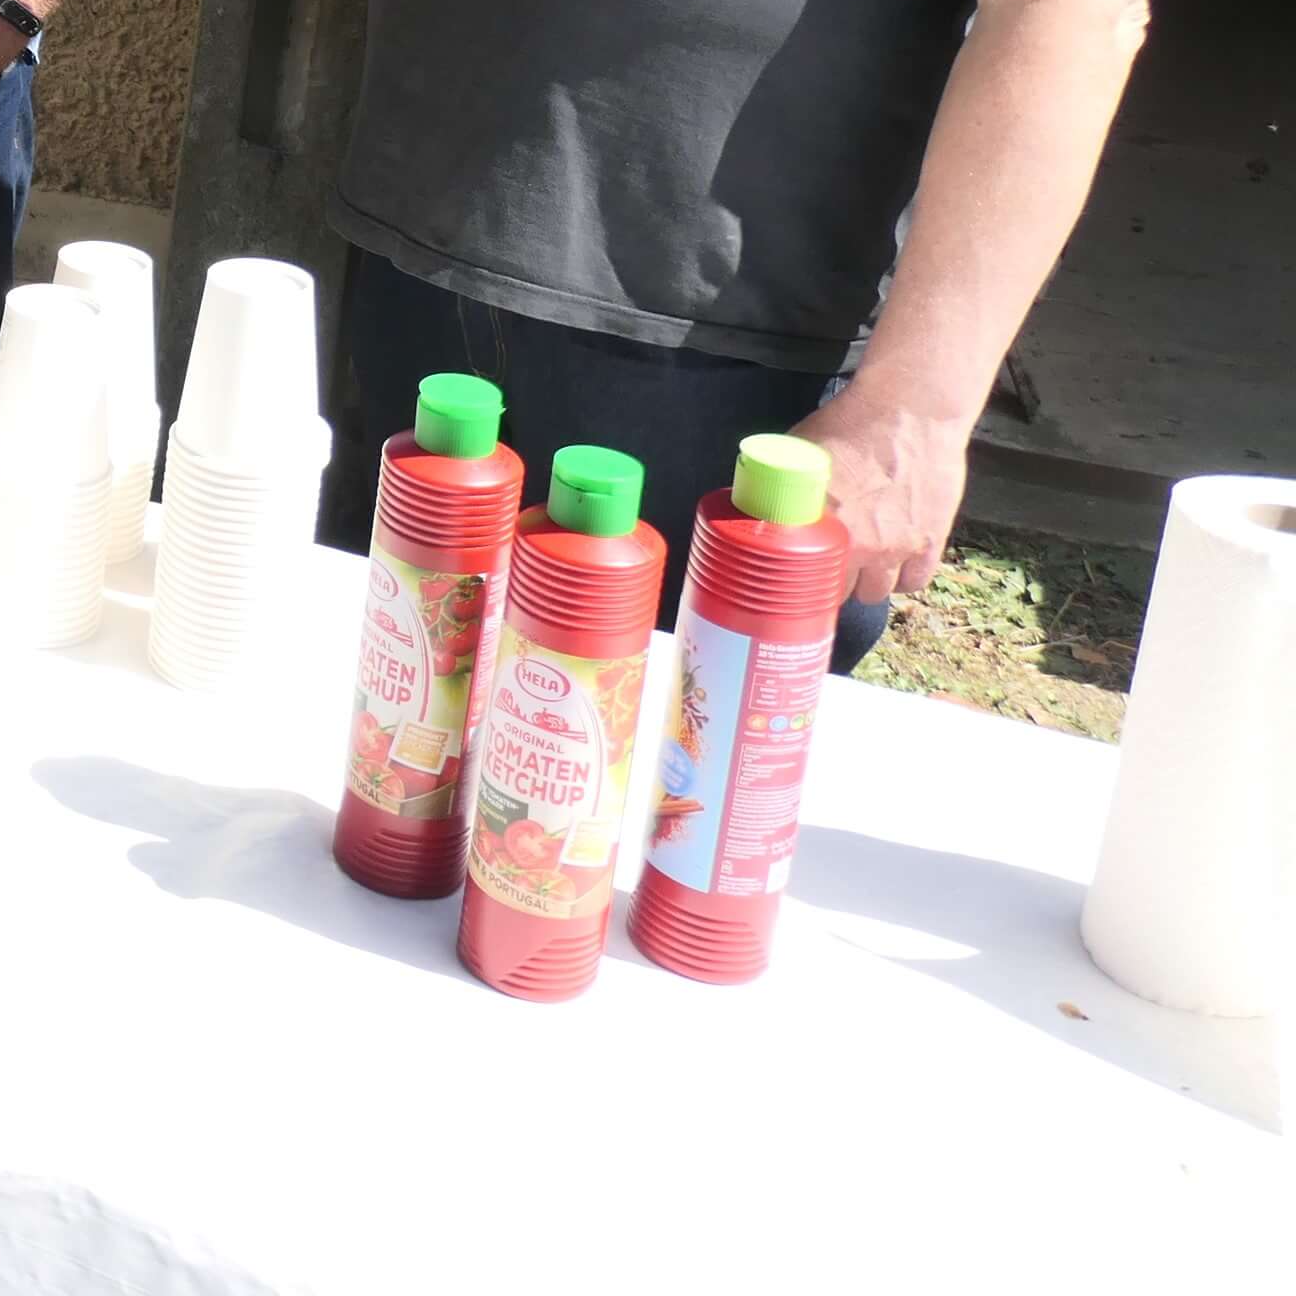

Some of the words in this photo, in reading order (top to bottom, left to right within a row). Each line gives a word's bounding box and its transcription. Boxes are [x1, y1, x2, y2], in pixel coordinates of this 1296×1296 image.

[360, 665, 411, 705] CHUP
[522, 669, 560, 693] HELA
[487, 721, 591, 785] TOMATEN
[504, 721, 565, 755] ORIGINAL
[484, 749, 584, 807] KETCHUP
[489, 870, 549, 913] PORTUGAL
